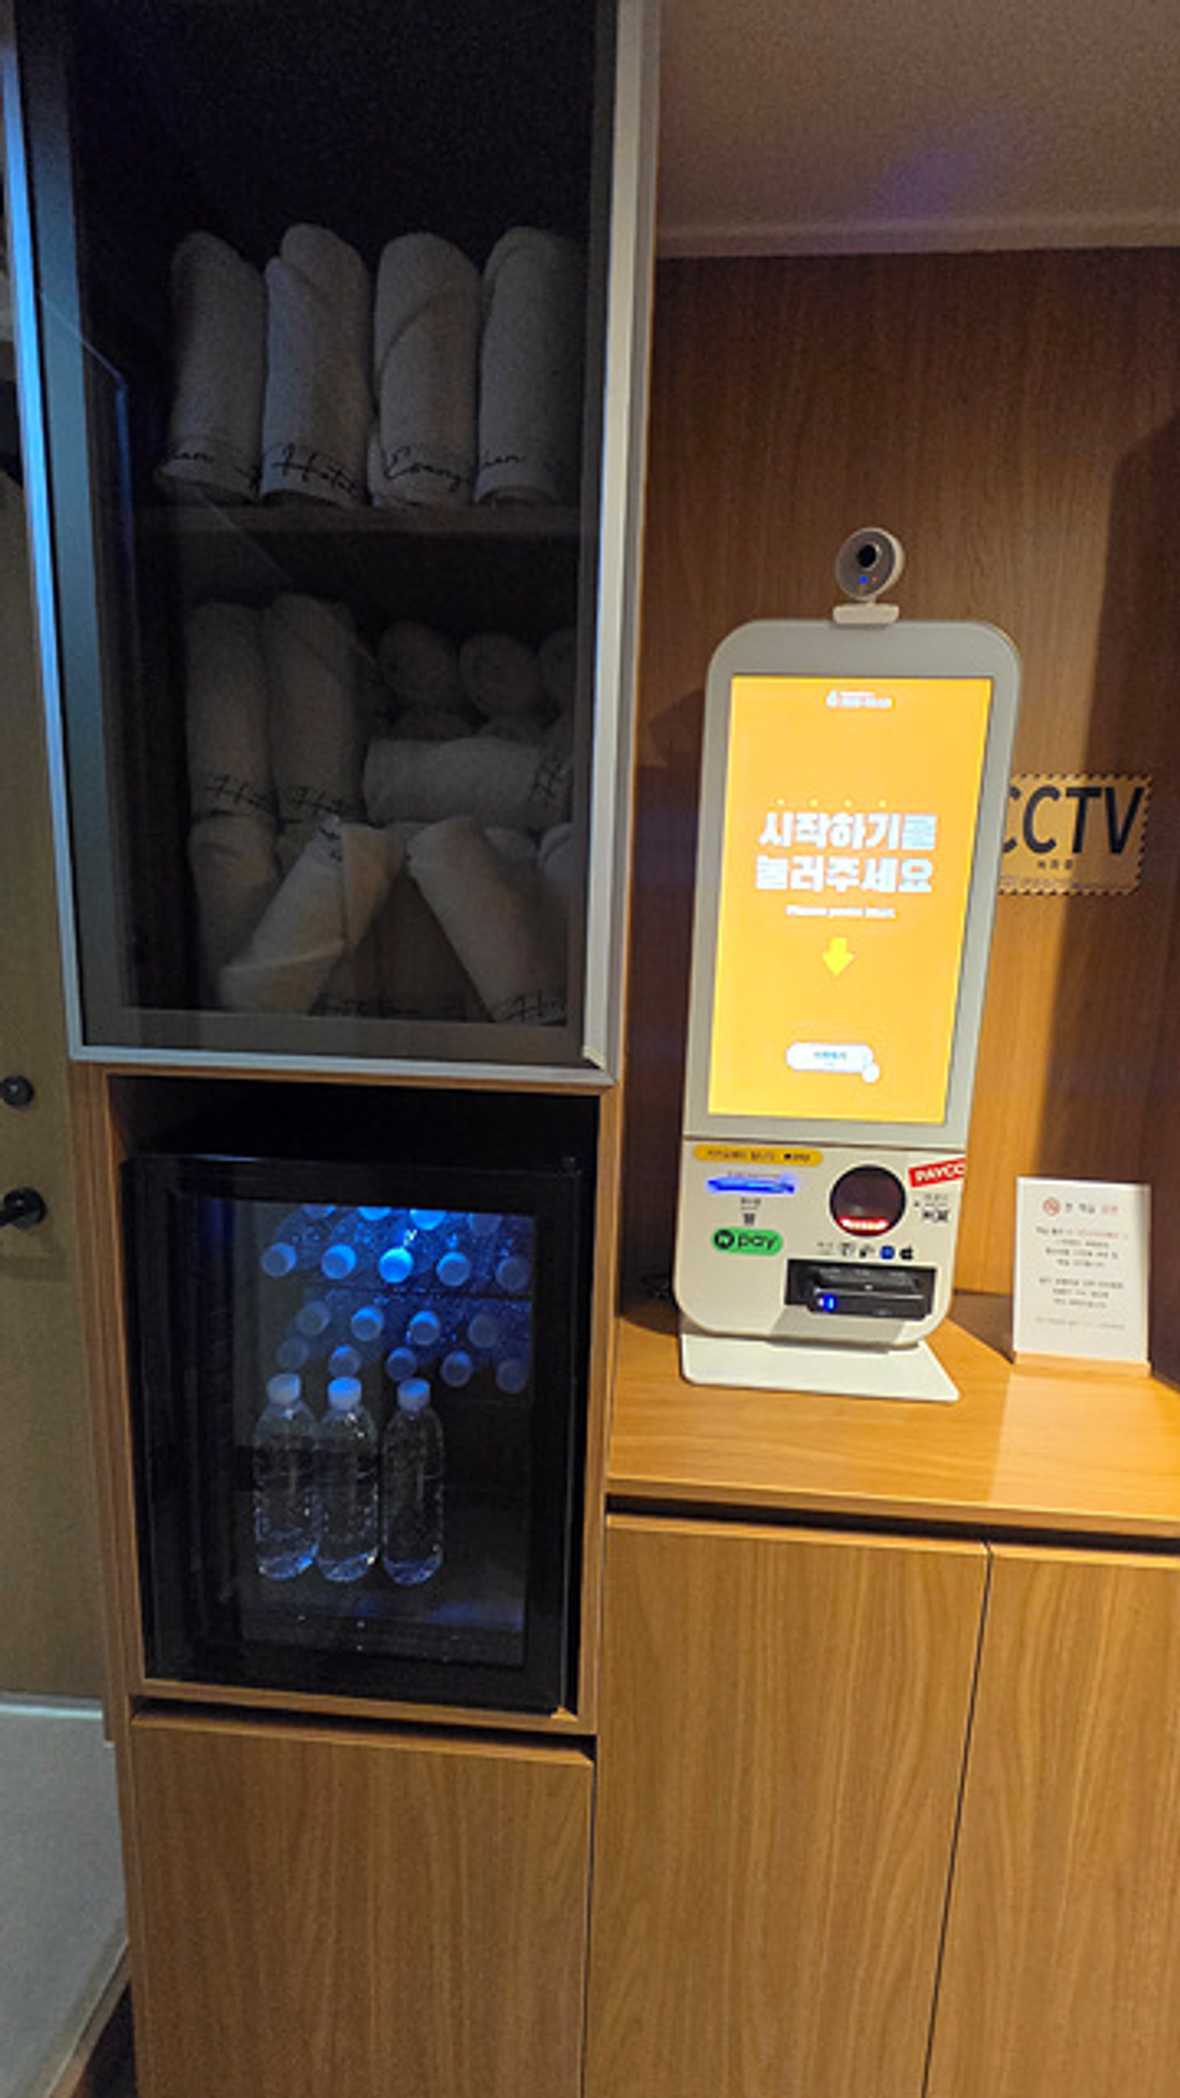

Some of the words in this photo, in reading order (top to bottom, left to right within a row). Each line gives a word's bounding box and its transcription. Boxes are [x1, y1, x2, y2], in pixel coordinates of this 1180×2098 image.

[758, 812, 937, 850] 시작하기를
[1003, 785, 1146, 854] CTV
[737, 1232, 778, 1250] pay
